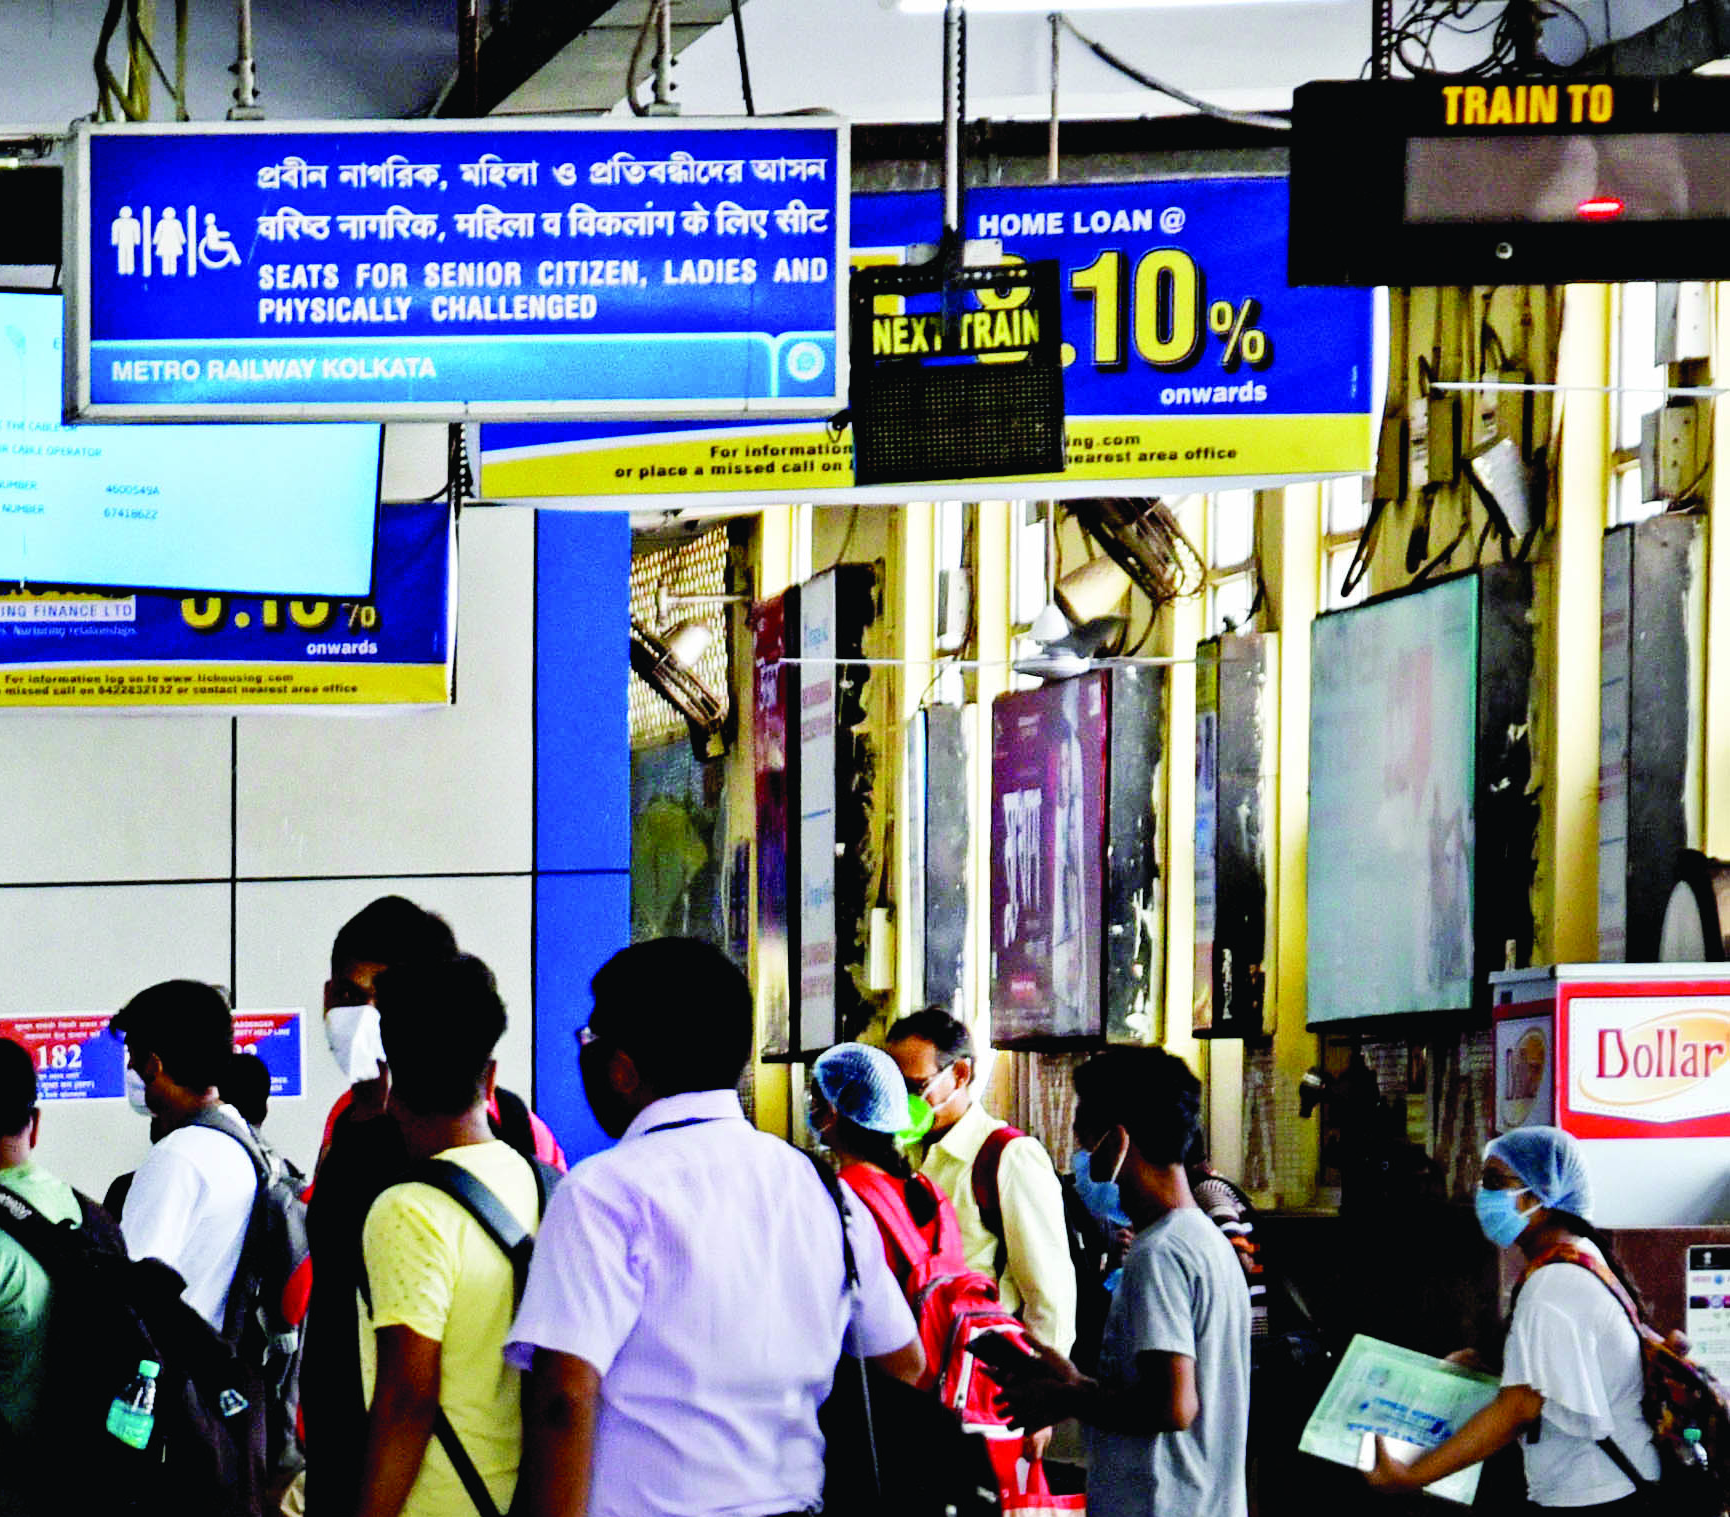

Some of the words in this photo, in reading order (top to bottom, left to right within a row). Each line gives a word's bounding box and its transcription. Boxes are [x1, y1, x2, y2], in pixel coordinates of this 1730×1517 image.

[1442, 84, 1558, 126] TRAIN
[1567, 84, 1614, 124] TO
[338, 154, 448, 191] নাগরিক,
[460, 153, 539, 188] মহিলা
[552, 162, 577, 186] ও
[589, 151, 745, 184] প্রতিবন্ধীদের
[749, 157, 827, 182] আসন
[257, 206, 331, 241] वरिष्ठ
[336, 205, 446, 243] नागरिक,
[453, 204, 535, 240] महिला
[541, 212, 562, 237] व
[567, 201, 676, 237] विकलांग
[680, 201, 709, 236] के
[714, 201, 769, 239] लिए
[774, 199, 829, 234] सीट
[979, 212, 1064, 237] HOME
[1073, 209, 1153, 234] LOAN
[1159, 206, 1186, 234] @
[259, 263, 339, 290] SEATS
[356, 263, 408, 289] FOR
[424, 262, 521, 288] SENIOR
[538, 260, 648, 288] CITIZEN,
[663, 258, 757, 285] LADIES
[773, 258, 828, 283] AND
[258, 296, 412, 323] PHYSICALLY
[431, 294, 597, 322] CHALLENGED
[872, 316, 942, 355] NEXT
[960, 309, 1039, 350] TRAIN
[111, 359, 200, 381] METRO
[207, 358, 315, 381] RAILWAY
[322, 355, 435, 378] KOLKATA
[1160, 380, 1268, 405] onwards
[46, 446, 102, 457] OPERATOR
[710, 445, 738, 458] For
[745, 443, 854, 458] information
[1137, 449, 1178, 462] area
[1184, 447, 1237, 460] office
[615, 466, 633, 478] or
[639, 464, 688, 480] place
[694, 465, 704, 476] a
[711, 461, 775, 475] missed
[782, 460, 814, 473] call
[821, 461, 842, 472] on
[34, 604, 97, 617] FINANCE
[105, 604, 132, 617] LTD
[306, 639, 378, 656] onwards
[4, 675, 24, 684] For
[37, 1044, 82, 1069] 182
[1596, 1028, 1725, 1078] Dollar
